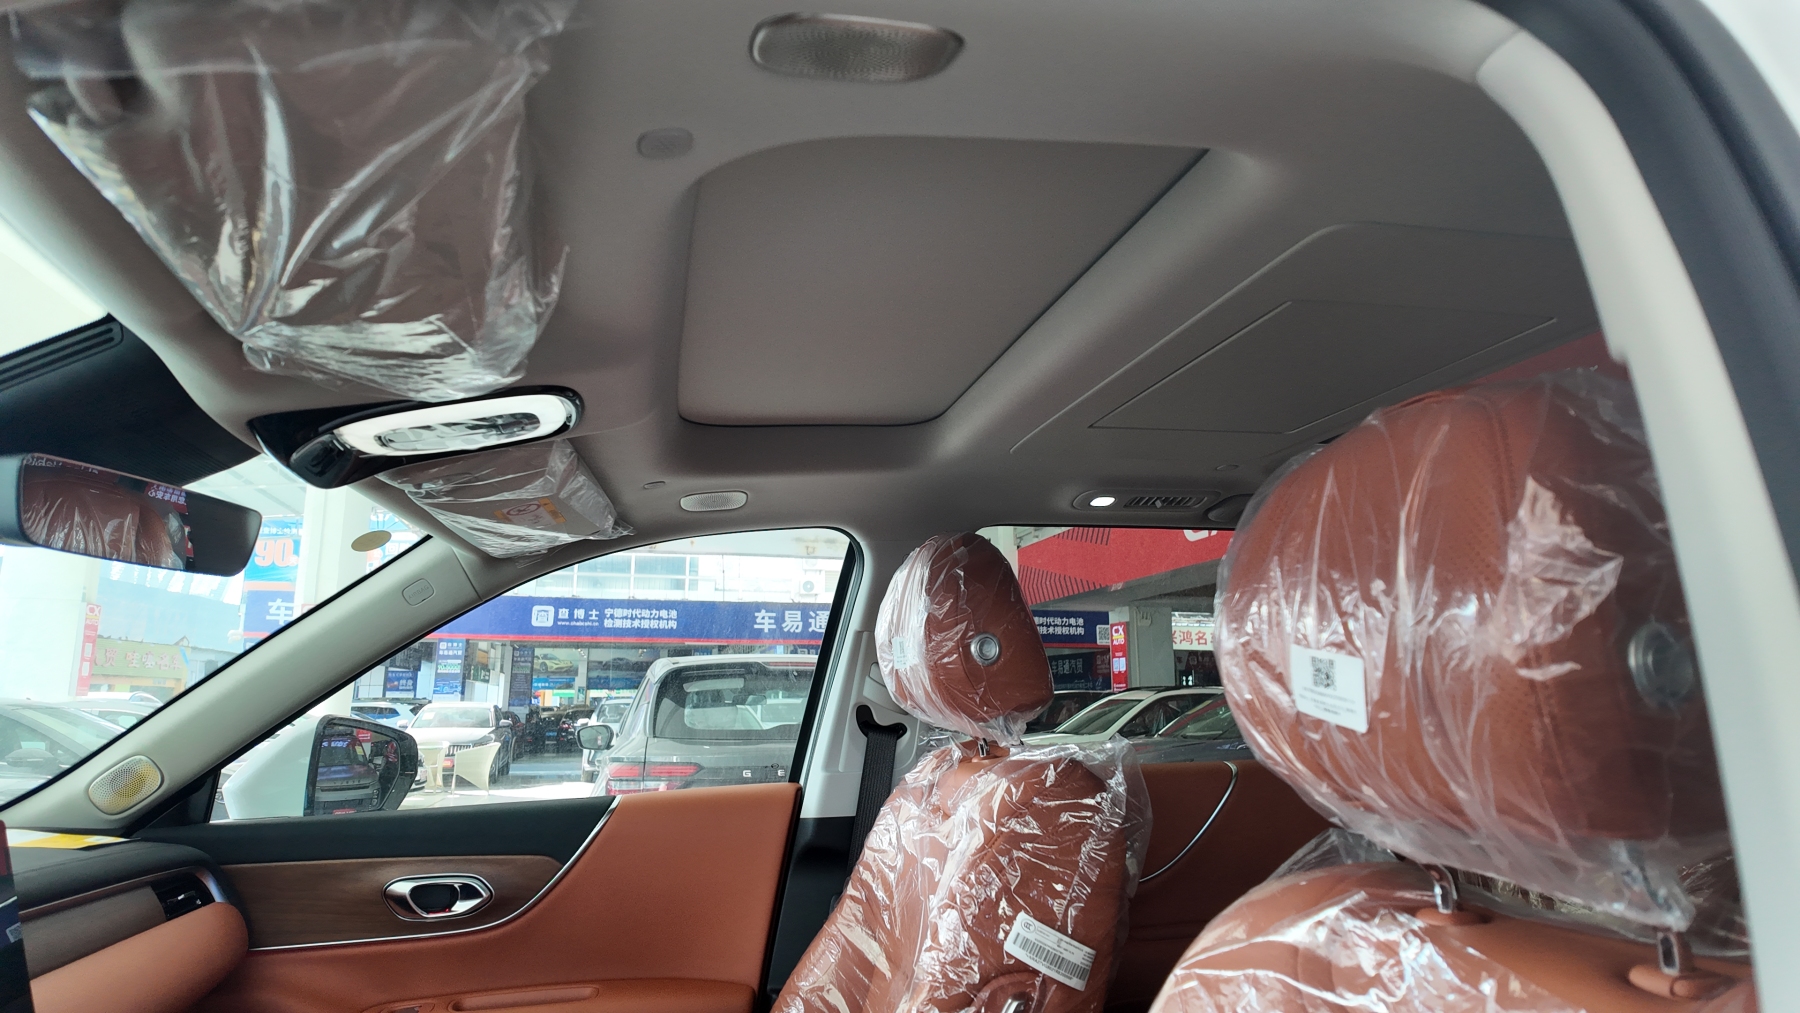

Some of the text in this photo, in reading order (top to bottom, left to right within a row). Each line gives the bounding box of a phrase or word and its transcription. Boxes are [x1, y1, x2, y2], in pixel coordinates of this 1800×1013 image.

[408, 584, 430, 600] AIRBAG
[86, 604, 101, 616] CX
[265, 598, 295, 626] 车
[557, 607, 600, 620] 查博士
[604, 608, 678, 619] 宁德时代动力电池
[604, 619, 678, 630] 检测技术授权机构
[753, 609, 830, 633] 车易通
[1112, 625, 1124, 636] CX
[1172, 630, 1214, 646] 鸿名
